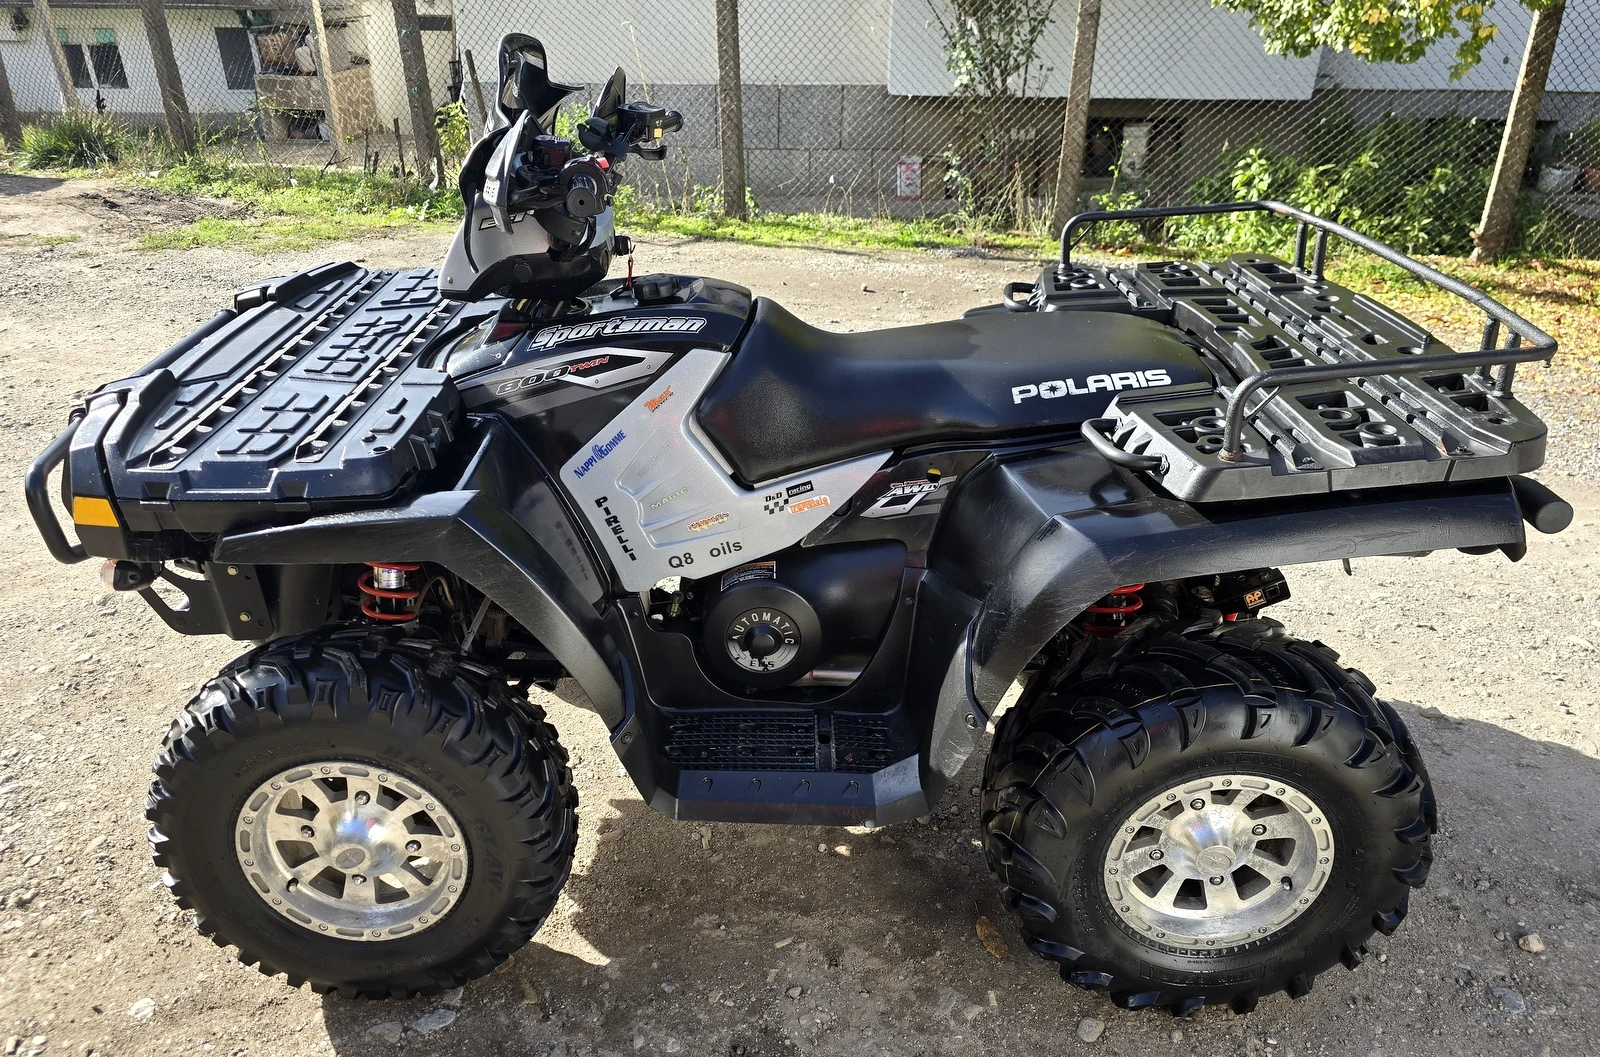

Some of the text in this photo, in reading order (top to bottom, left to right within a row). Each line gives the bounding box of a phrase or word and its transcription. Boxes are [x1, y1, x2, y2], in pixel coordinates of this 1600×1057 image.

[527, 316, 707, 351] Sportsman
[496, 356, 610, 395] 800 TWIN
[1011, 369, 1172, 404] POLARIS
[573, 429, 627, 479] NAPPI GOMME
[650, 487, 688, 510] MAGIC
[788, 483, 812, 496] racing
[594, 496, 637, 561] PIRELLI
[667, 538, 743, 569] Q8 oils
[732, 612, 795, 645] AUTOMATIC
